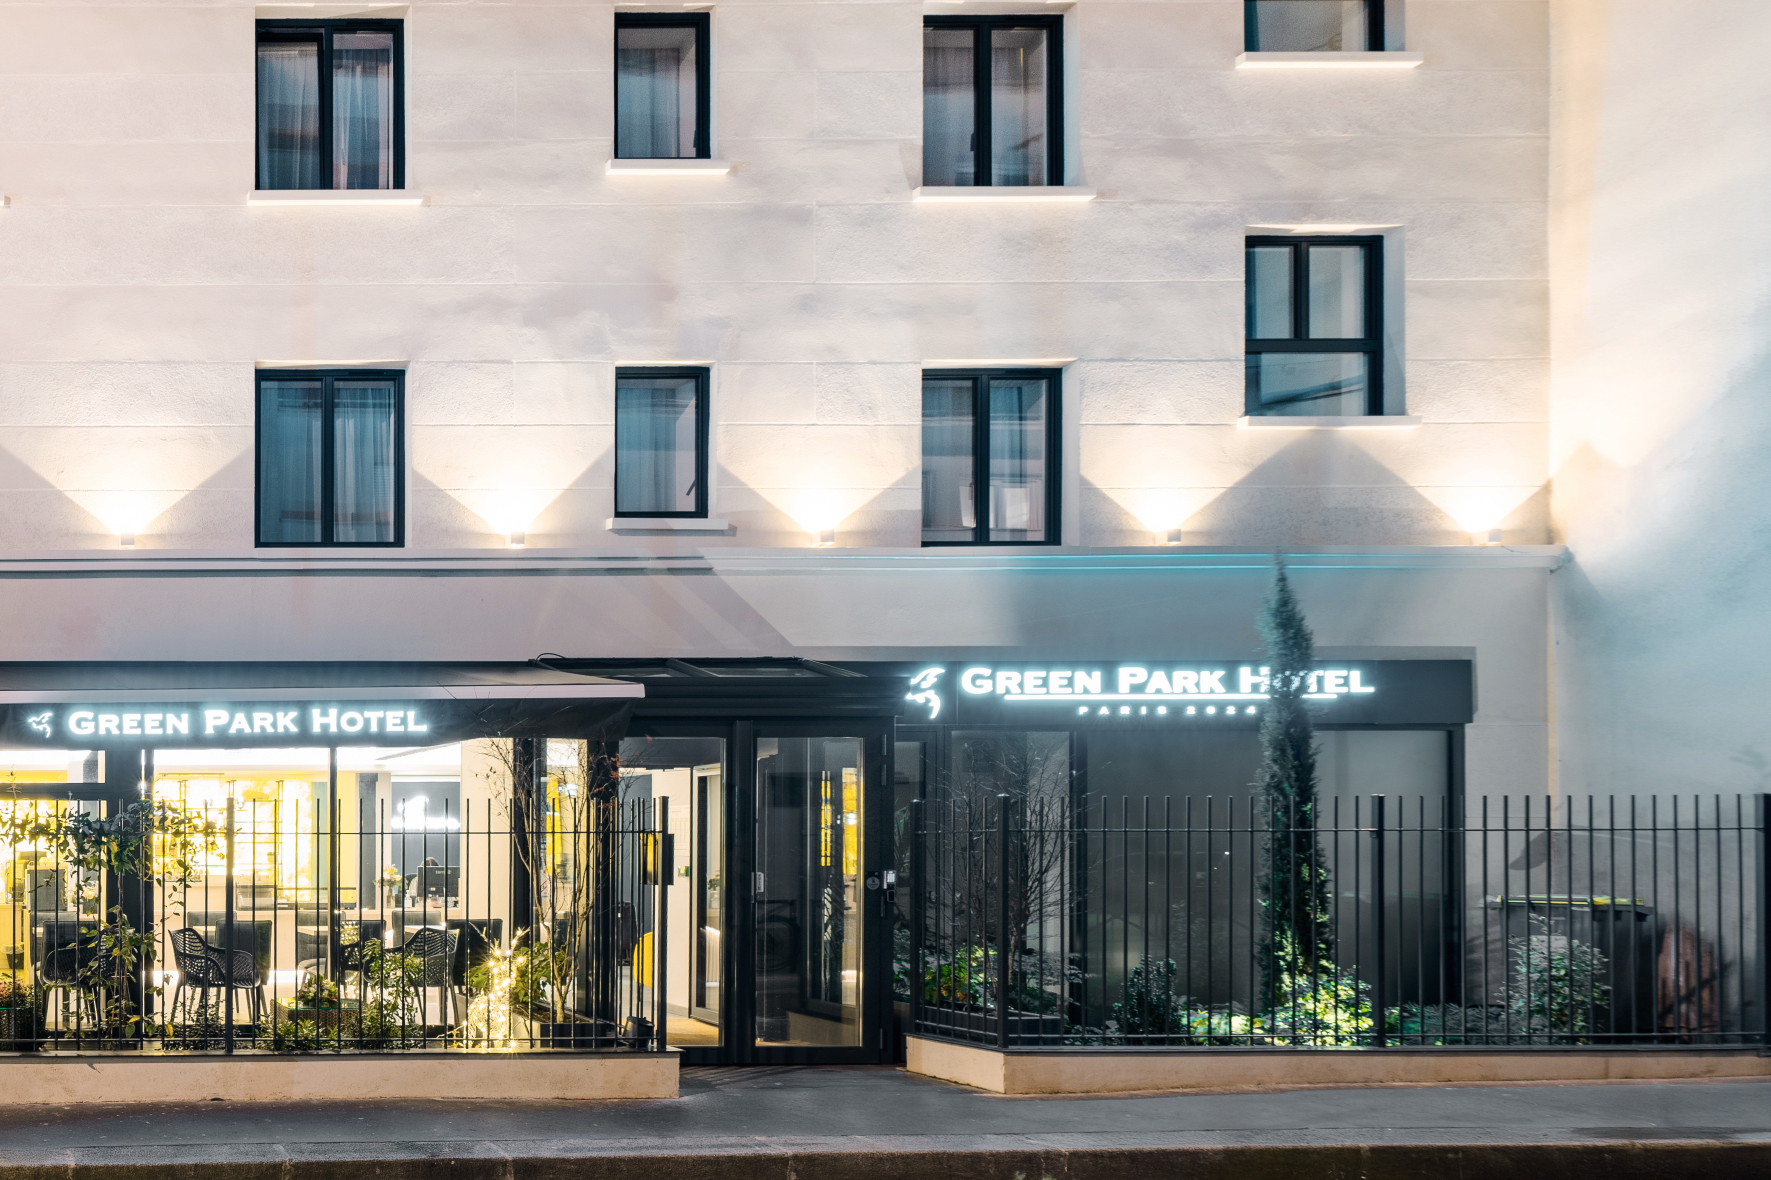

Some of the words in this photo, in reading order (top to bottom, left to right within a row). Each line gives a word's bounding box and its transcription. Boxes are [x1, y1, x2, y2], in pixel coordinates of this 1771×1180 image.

[960, 667, 1102, 695] GREEN
[1118, 666, 1227, 694] PARK
[68, 710, 190, 735] GREEN
[203, 708, 299, 735] PARK
[311, 707, 428, 733] HOTEL
[1078, 705, 1168, 716] PARIS
[1185, 705, 1257, 716] 2024
